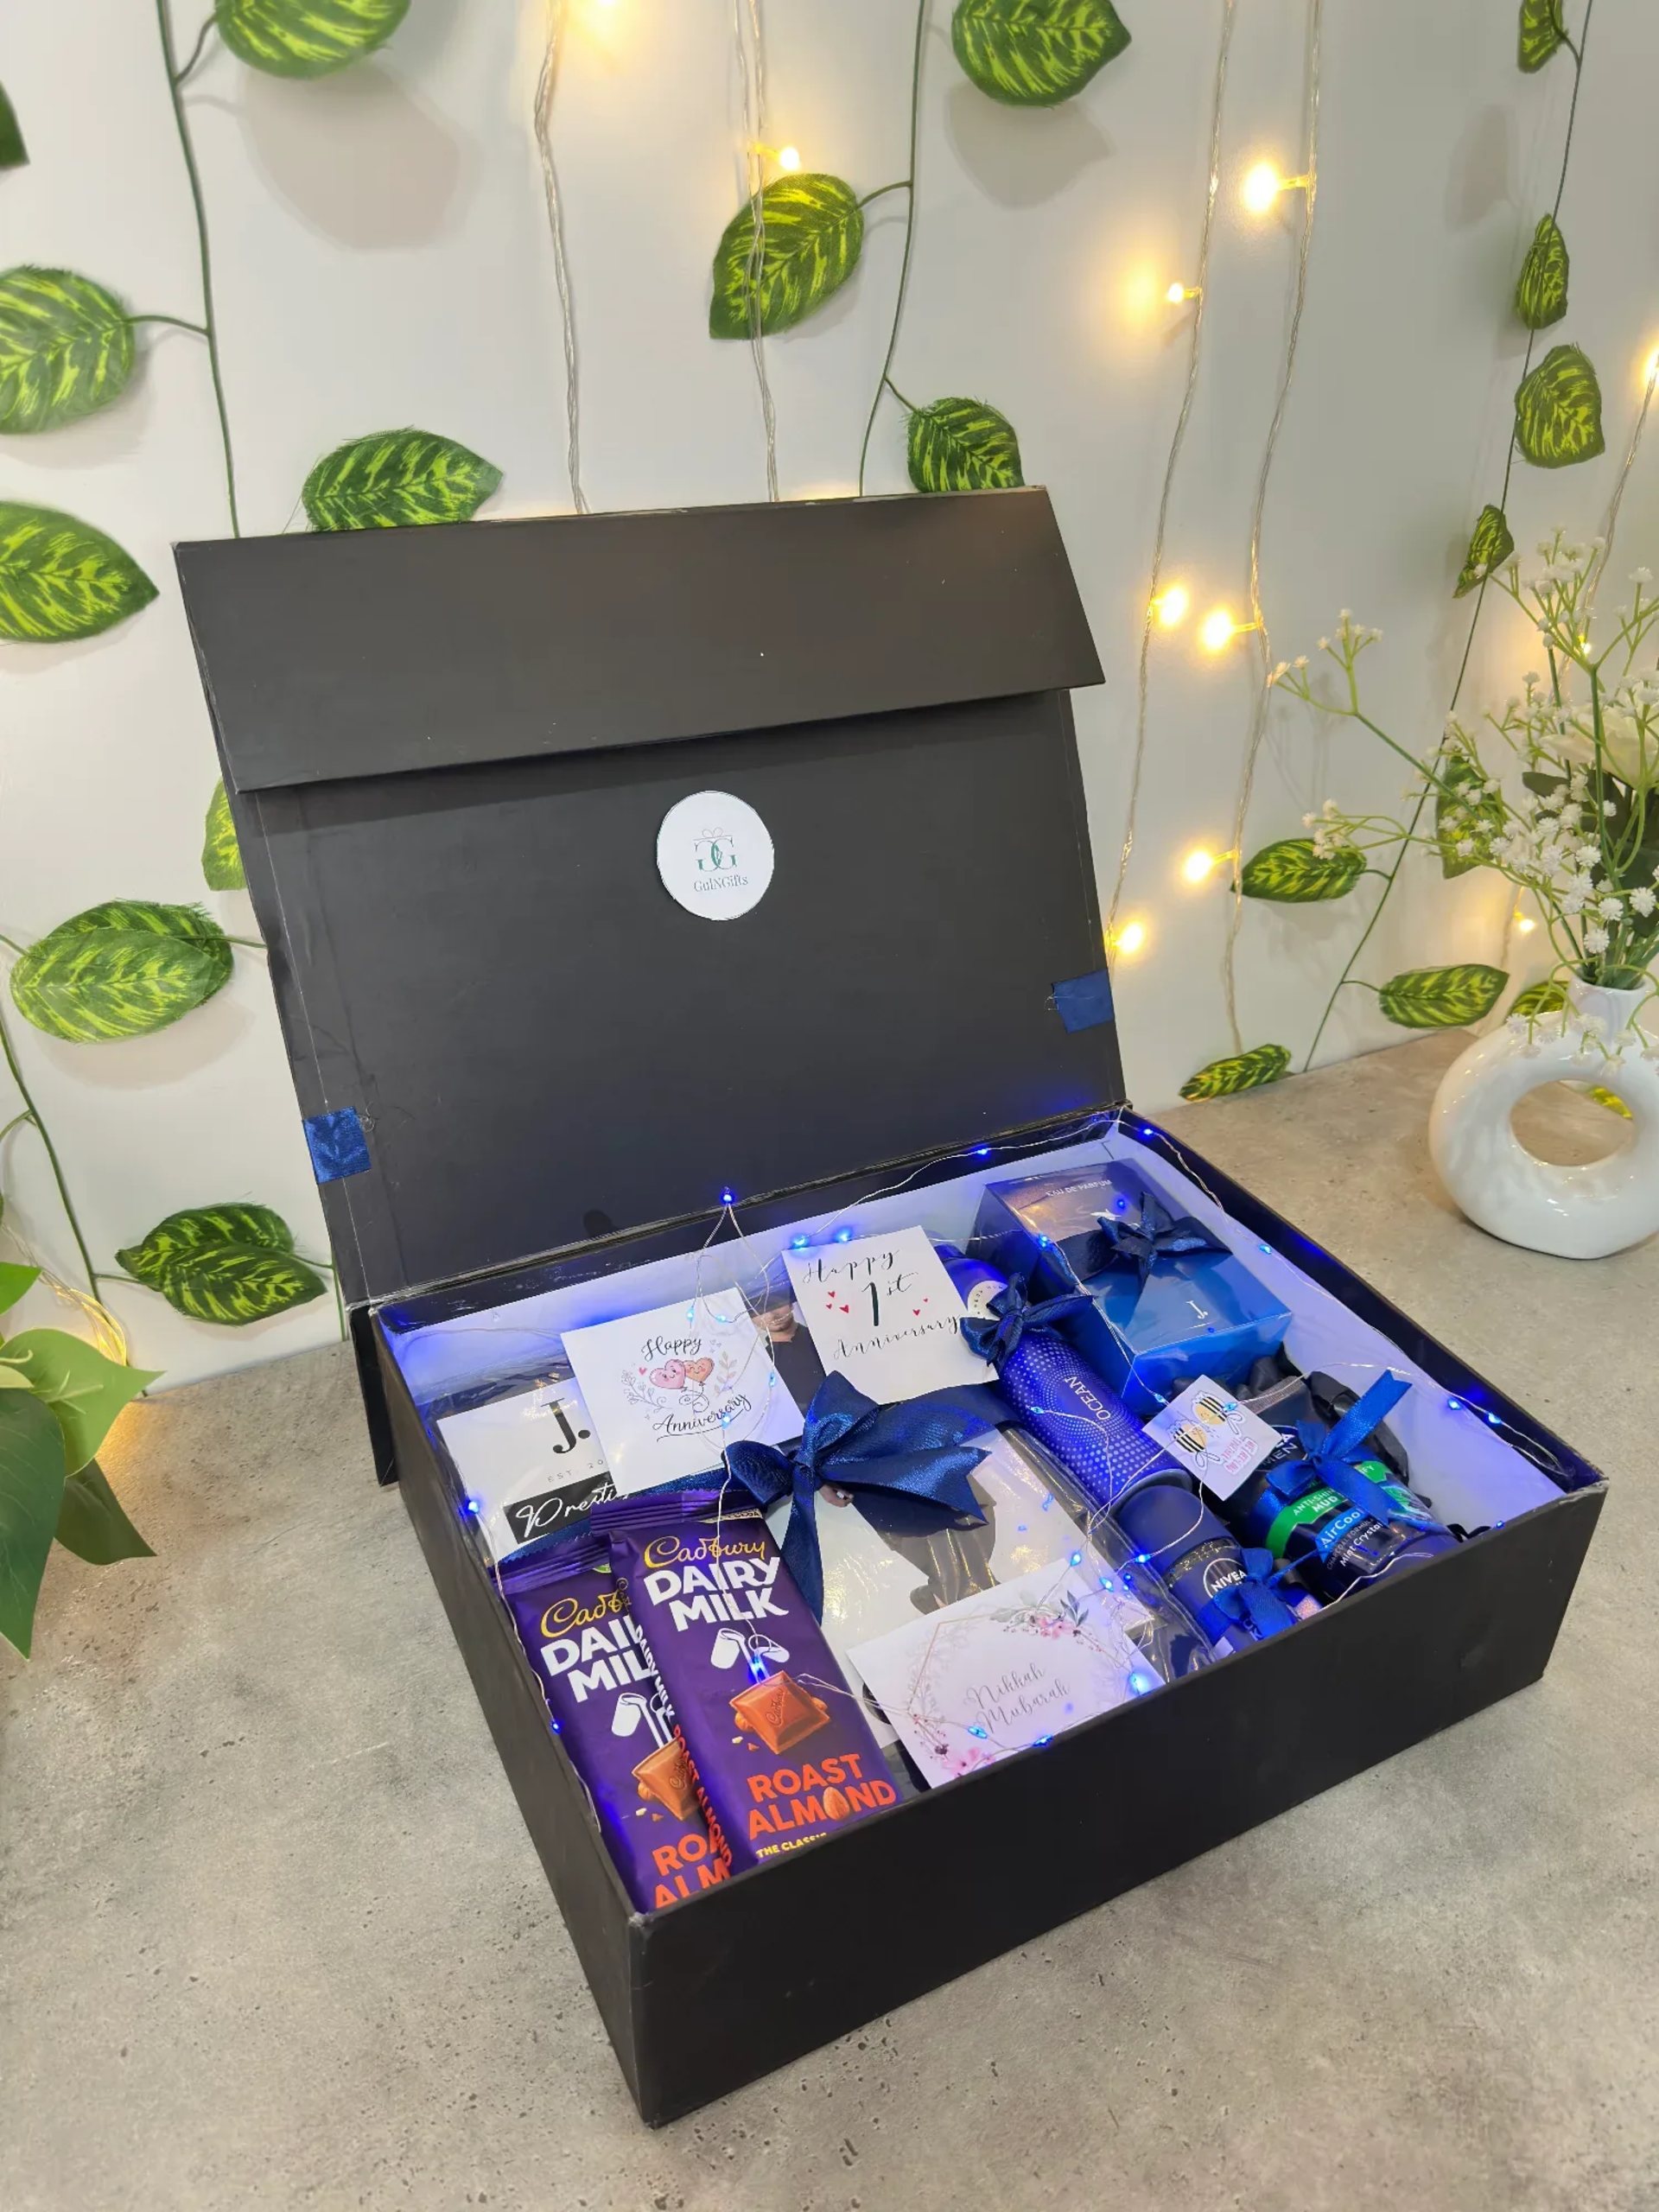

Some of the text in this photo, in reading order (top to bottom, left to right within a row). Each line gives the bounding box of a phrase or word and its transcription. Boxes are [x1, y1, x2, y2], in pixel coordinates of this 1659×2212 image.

[802, 1249, 899, 1284] Happy
[861, 1271, 919, 1327] 1st
[641, 1335, 702, 1362] Happy
[833, 1314, 961, 1361] Anniversary
[652, 1393, 752, 1442] Anniversary
[1065, 1376, 1111, 1421] OCEAN
[540, 1397, 591, 1454] J.
[588, 1459, 604, 1470] 20
[515, 1482, 629, 1539] Presti
[1313, 1495, 1338, 1514] MUD
[644, 1535, 766, 1569] Cadbury
[643, 1556, 780, 1606] DAIRY
[1211, 1568, 1248, 1592] NIVEA
[540, 1591, 624, 1638] Cadb
[669, 1586, 790, 1632] MILK
[567, 1649, 654, 1703] MIL
[747, 1753, 862, 1803] ROAST
[756, 1844, 779, 1859] THE
